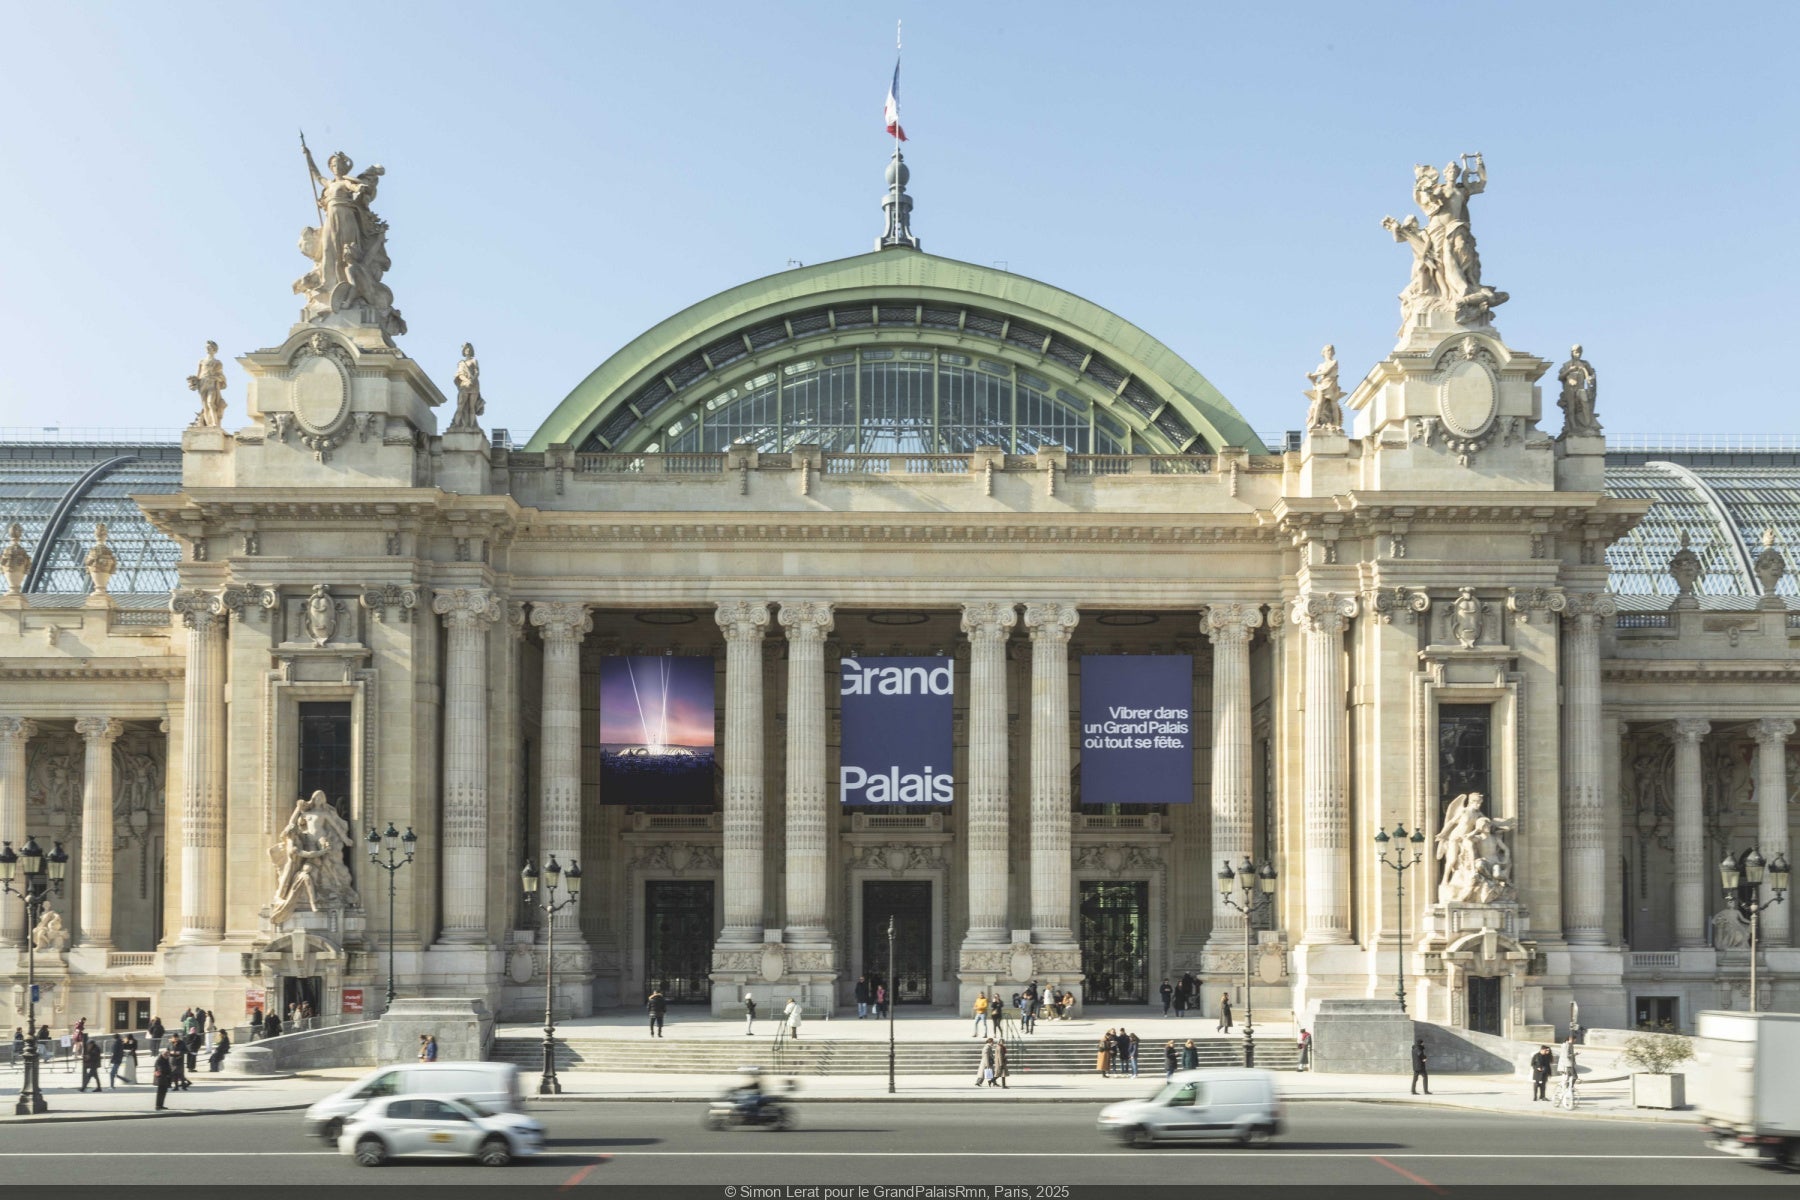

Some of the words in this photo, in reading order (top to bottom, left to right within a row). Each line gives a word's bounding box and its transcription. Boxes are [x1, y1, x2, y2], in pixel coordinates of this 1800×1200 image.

[841, 658, 954, 695] Grand
[1108, 706, 1152, 719] Vibrer
[1153, 706, 1189, 719] dans
[1084, 723, 1102, 734] un
[1103, 720, 1148, 734] Grand
[1148, 720, 1189, 734] Palais
[1084, 735, 1104, 749] où
[1104, 735, 1133, 749] tout
[1134, 738, 1152, 749] se
[1153, 735, 1185, 749] fête.
[840, 766, 954, 802] Palais
